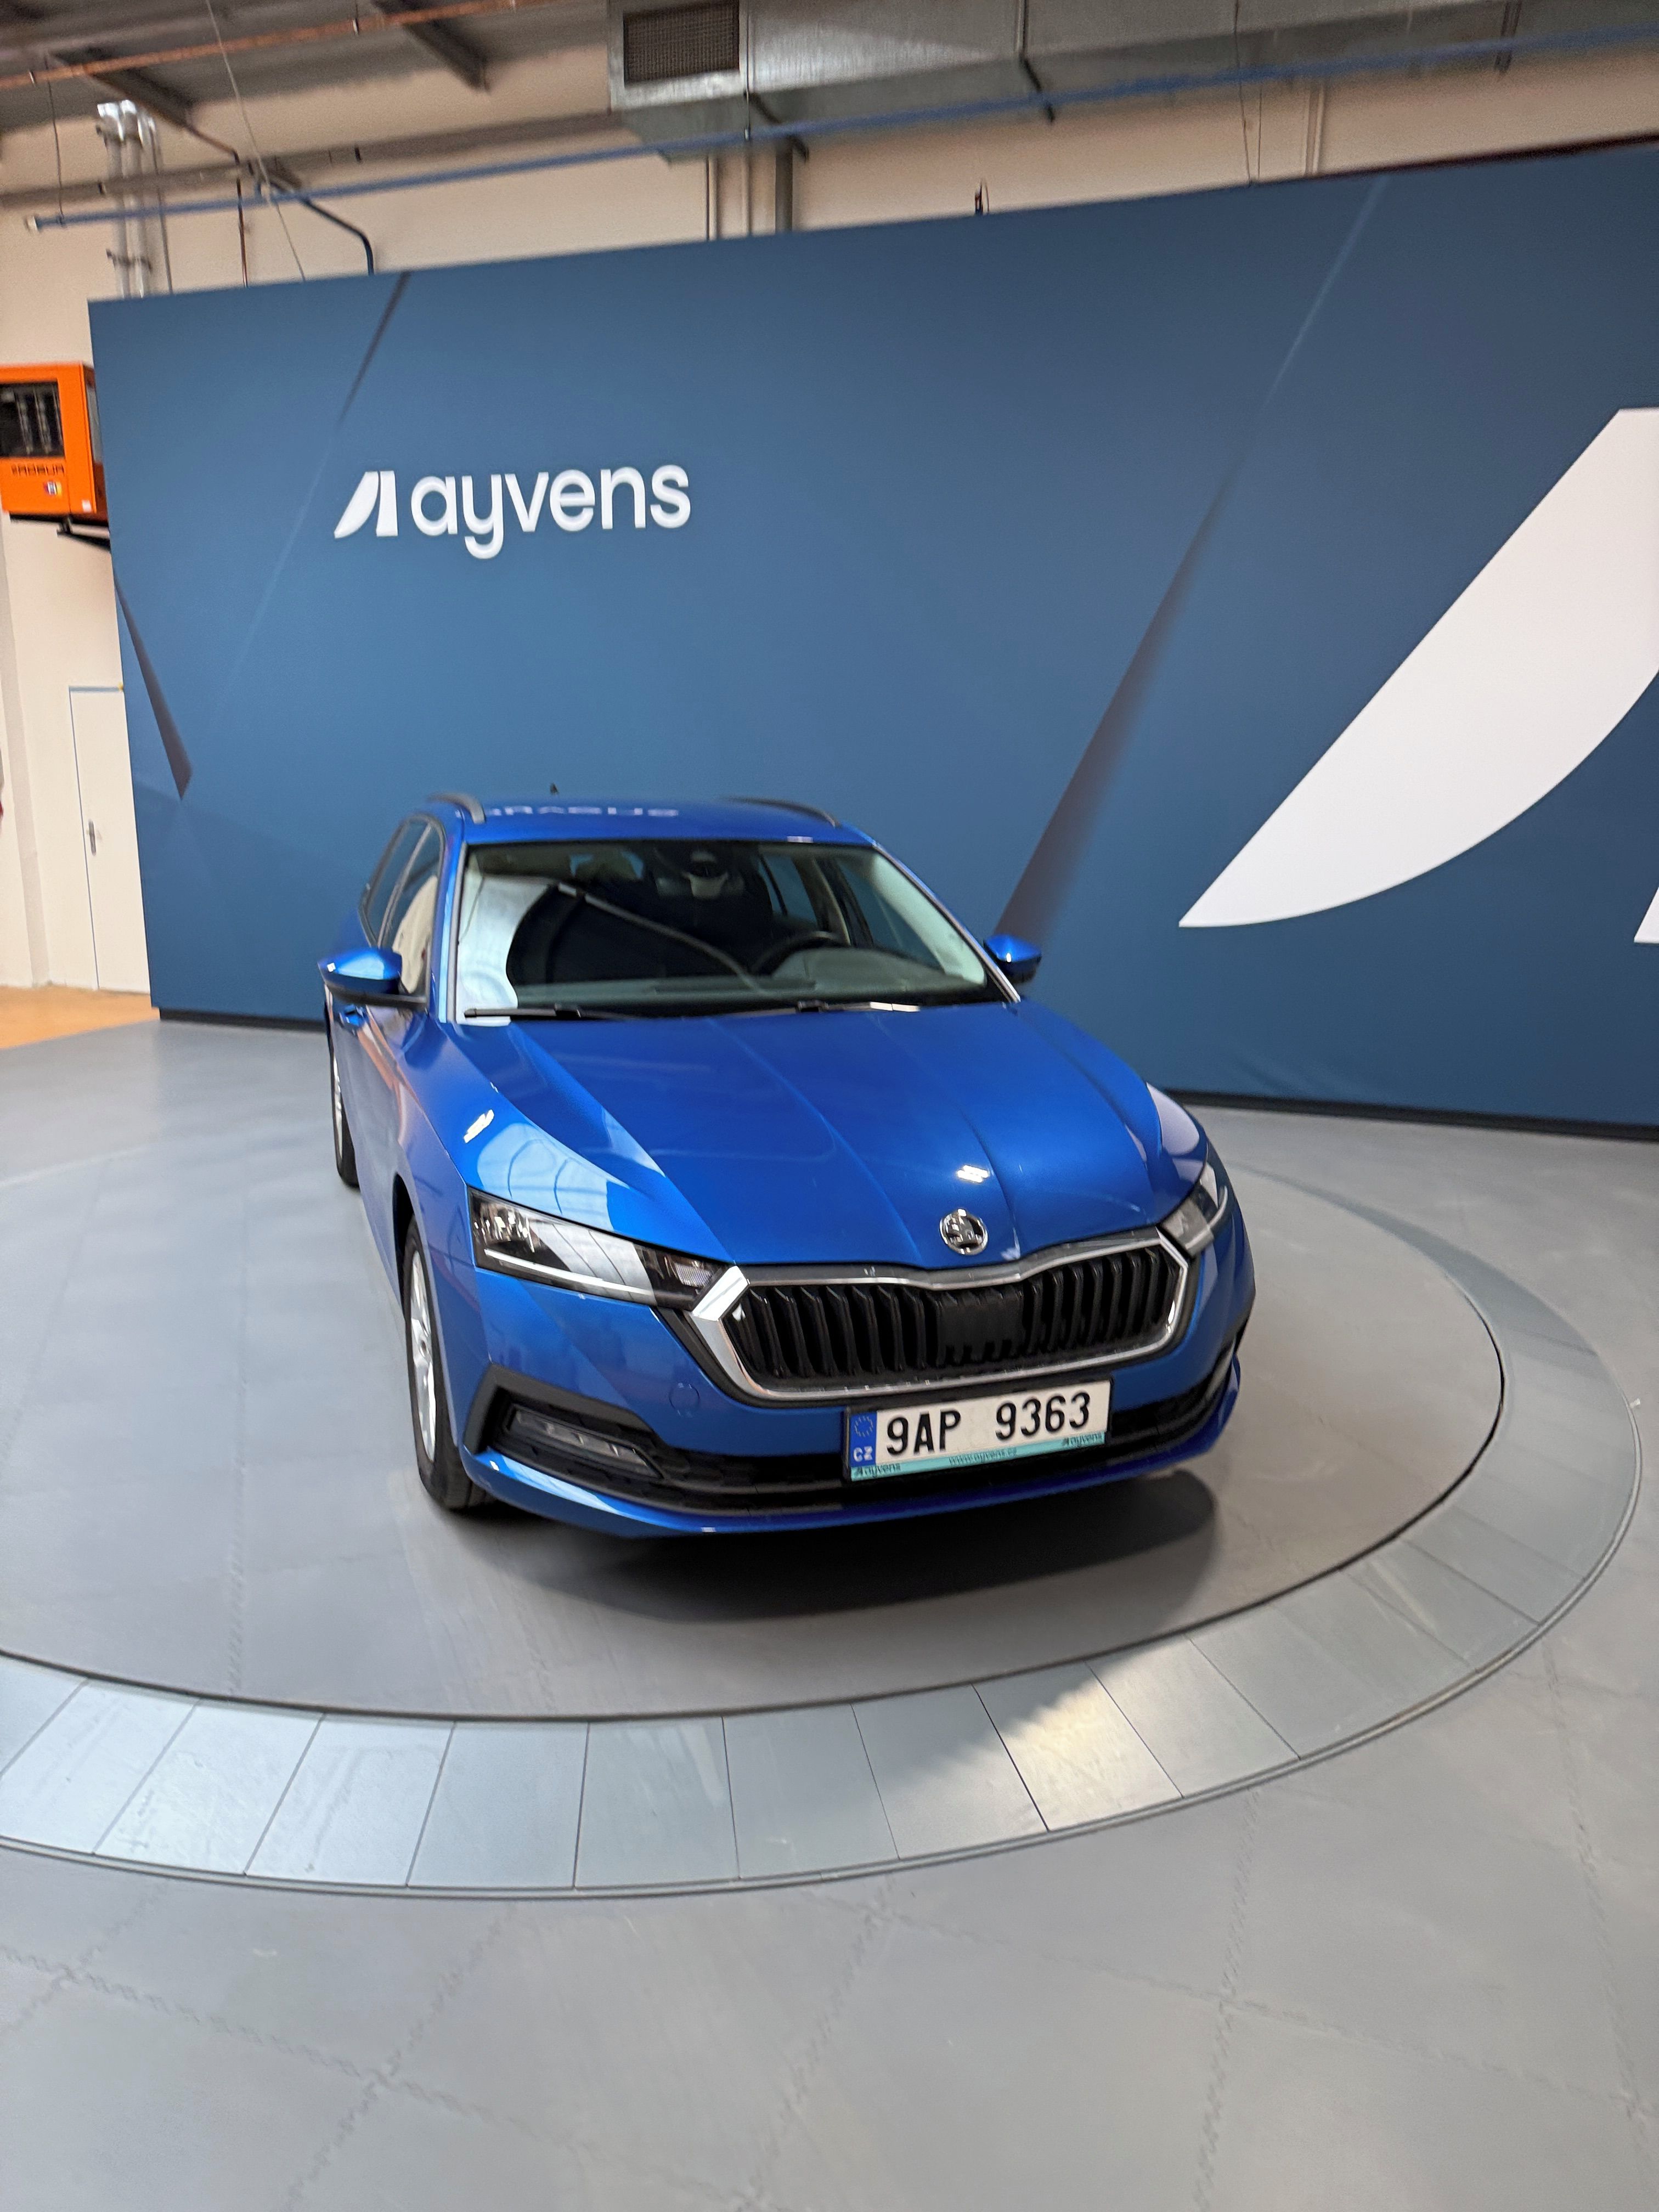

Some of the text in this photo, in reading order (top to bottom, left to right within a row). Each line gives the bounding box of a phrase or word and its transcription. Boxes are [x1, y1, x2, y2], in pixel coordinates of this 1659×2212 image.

[410, 464, 691, 560] ayvens
[853, 1446, 873, 1462] CZ
[885, 1391, 1091, 1456] 9AP 9363
